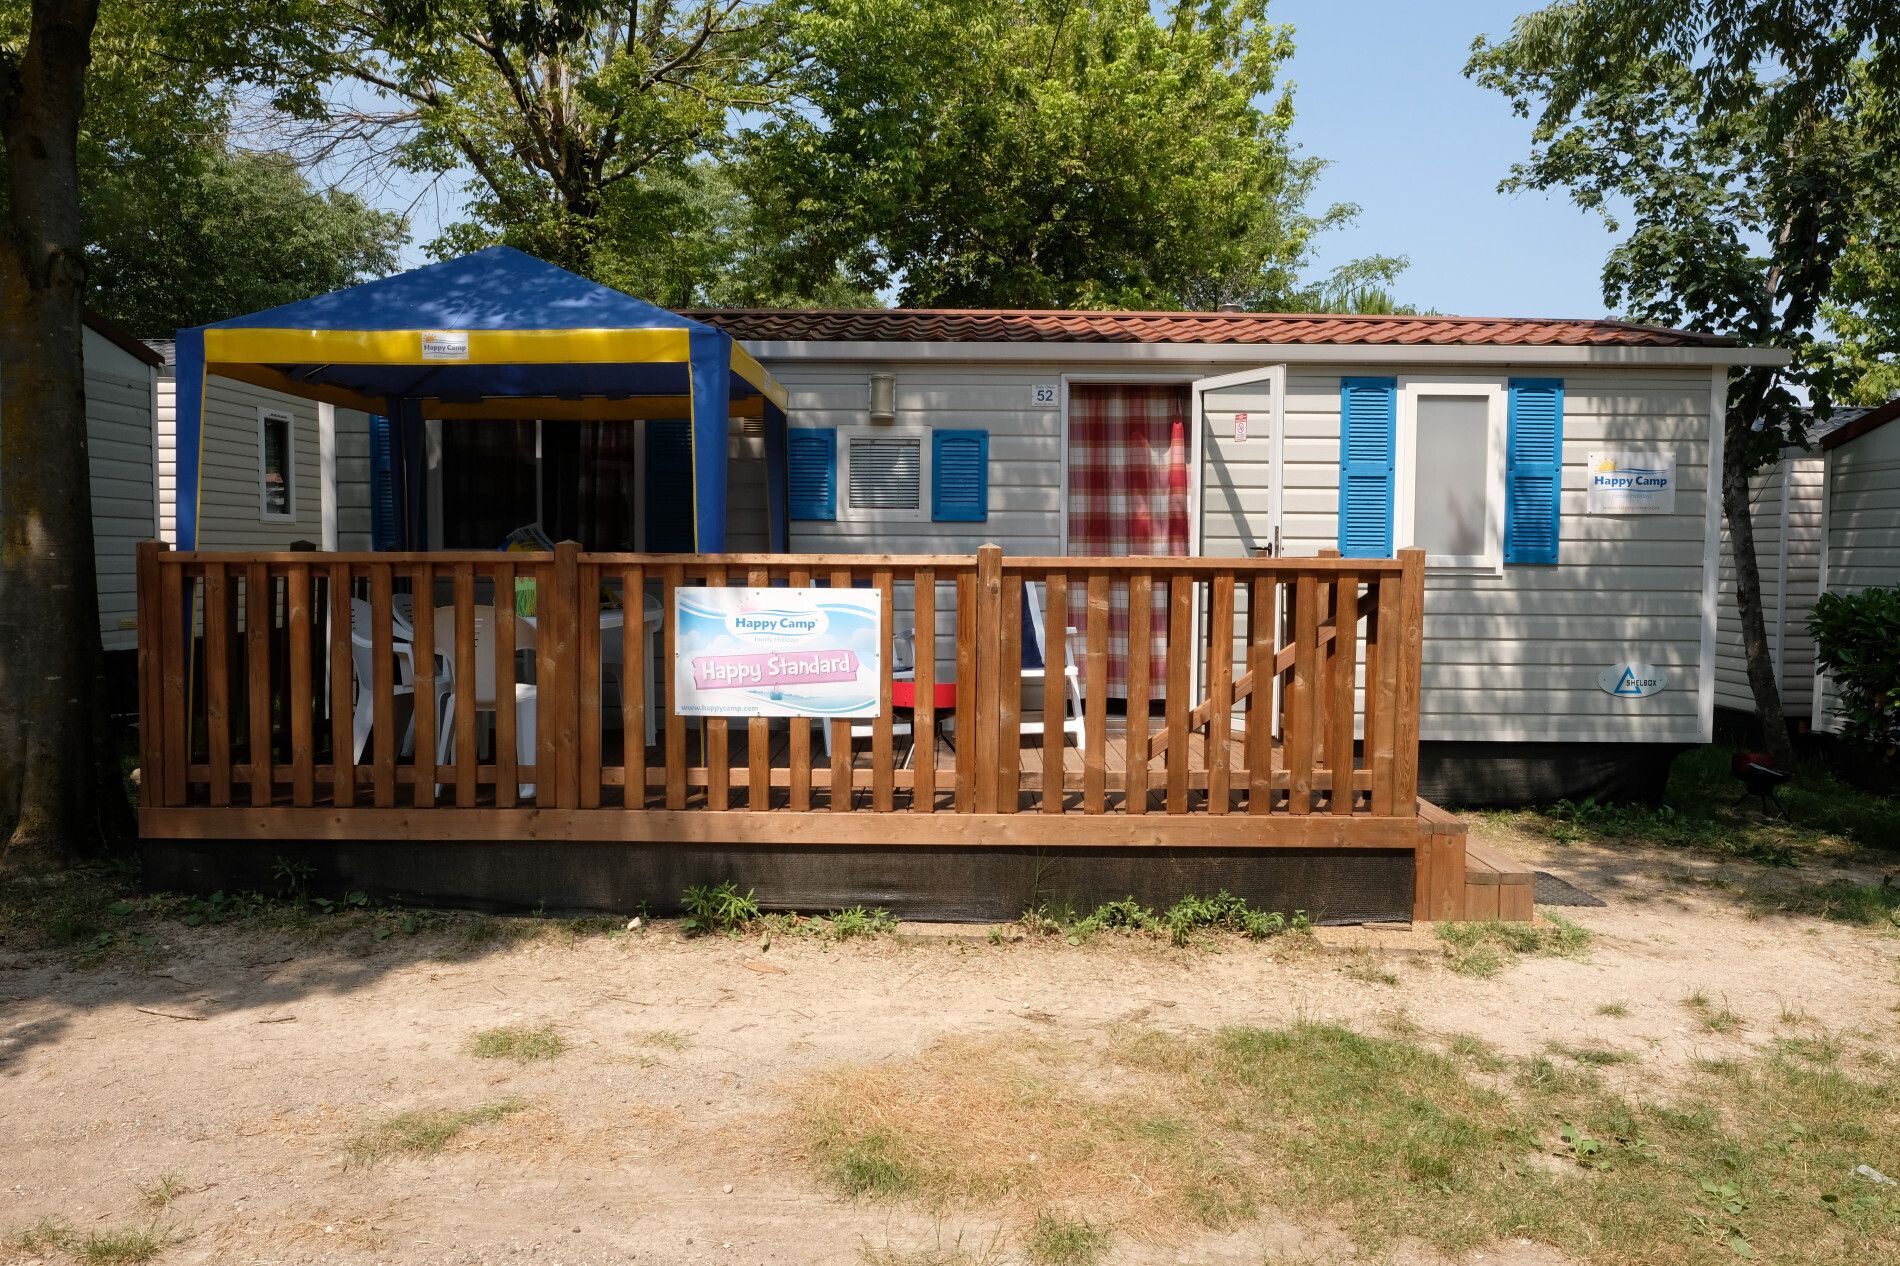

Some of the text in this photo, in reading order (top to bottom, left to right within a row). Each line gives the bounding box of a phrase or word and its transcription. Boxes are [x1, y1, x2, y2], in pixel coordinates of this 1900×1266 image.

[424, 344, 467, 352] Happy Camp
[1037, 390, 1053, 401] 52
[1594, 475, 1667, 488] Happy Camp
[735, 617, 816, 631] Happy Camp
[702, 653, 851, 685] Happy Standard
[1626, 679, 1657, 687] SHELBOX
[681, 703, 759, 714] www.happycamp.com
